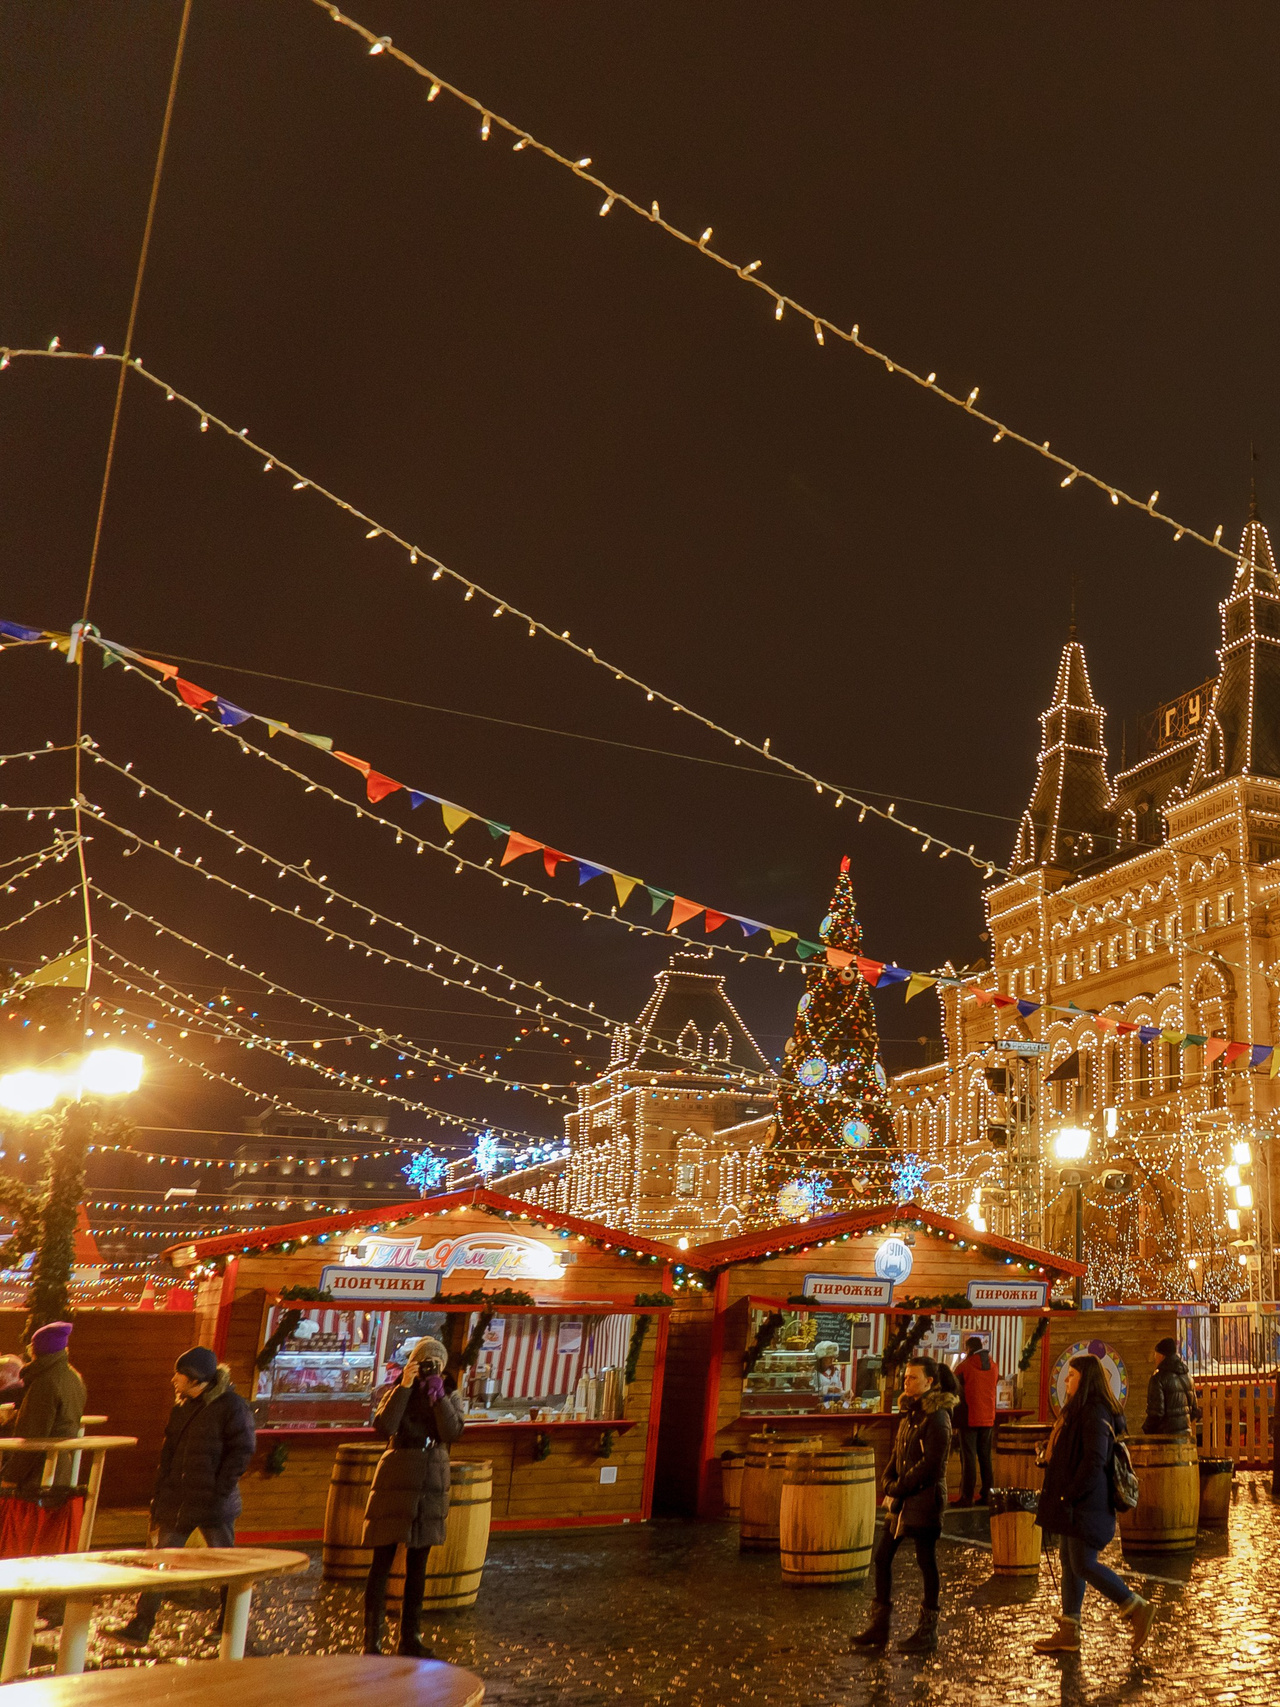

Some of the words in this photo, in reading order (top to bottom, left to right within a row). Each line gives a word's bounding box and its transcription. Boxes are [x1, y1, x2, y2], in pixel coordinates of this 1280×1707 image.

[360, 1236, 540, 1274] ГУМ-Ярмарк
[333, 1276, 426, 1291] ПОНЧИКИ
[812, 1283, 884, 1297] ПИРОЖКИ
[975, 1289, 1039, 1300] ПИРОЖКИ
